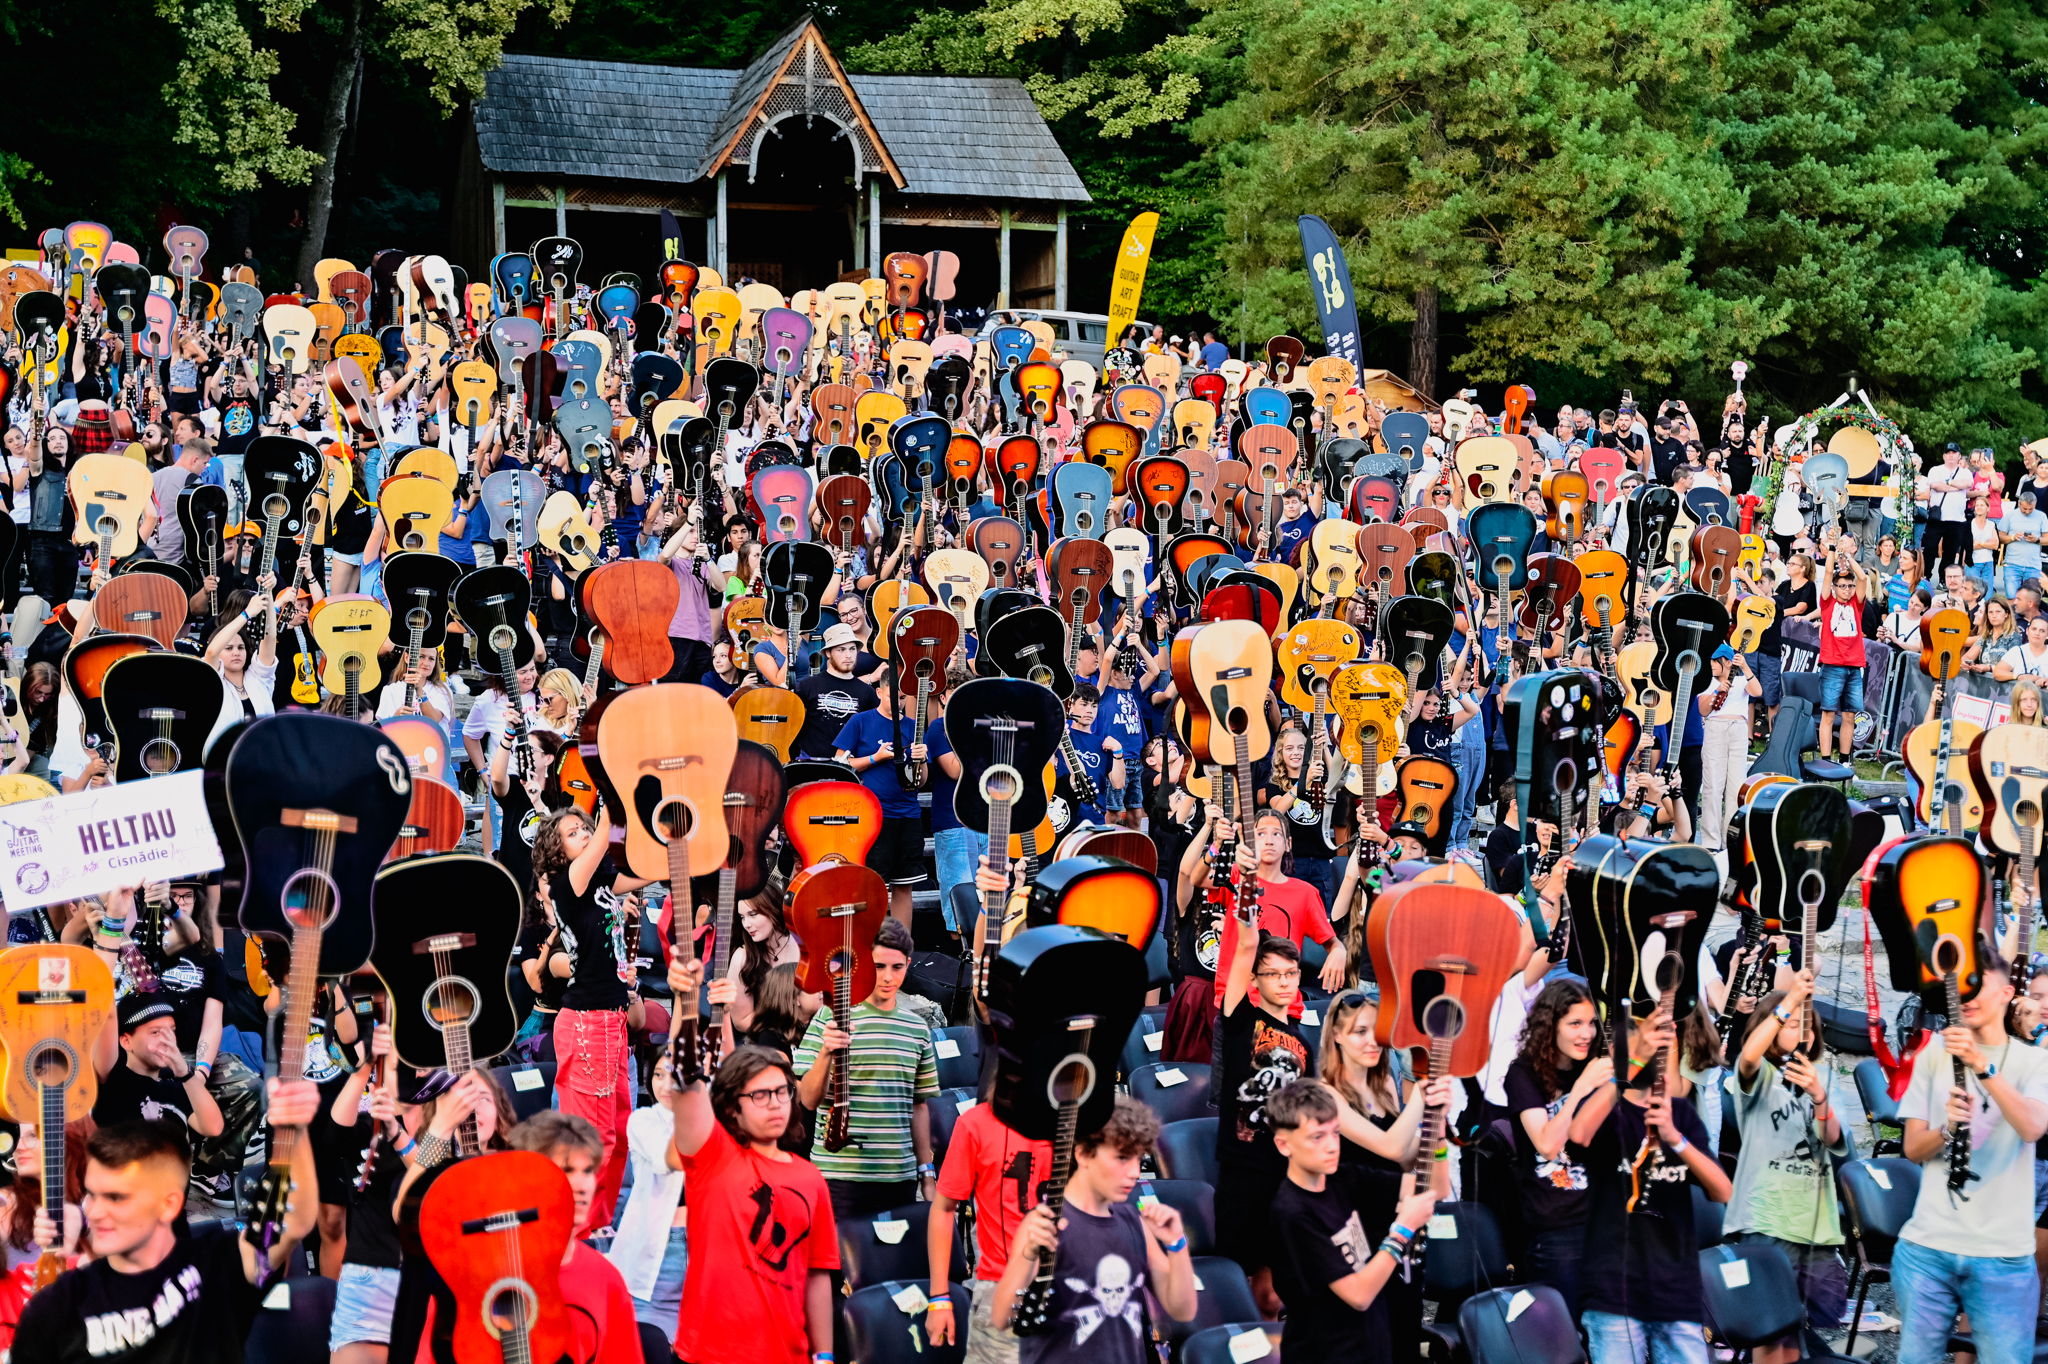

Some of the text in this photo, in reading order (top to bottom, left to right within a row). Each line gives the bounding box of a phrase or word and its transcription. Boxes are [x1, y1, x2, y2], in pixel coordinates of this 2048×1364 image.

[1120, 268, 1140, 284] GUITAR
[1119, 286, 1133, 301] ART
[1112, 304, 1133, 320] CRAFT
[78, 808, 176, 855] HELTAU
[7, 834, 40, 849] GUITAR
[10, 844, 43, 858] MEETING
[108, 848, 169, 869] Cisnădie
[42, 920, 55, 942] mâna
[1771, 1100, 1801, 1132] PUN
[84, 1306, 156, 1357] BINE
